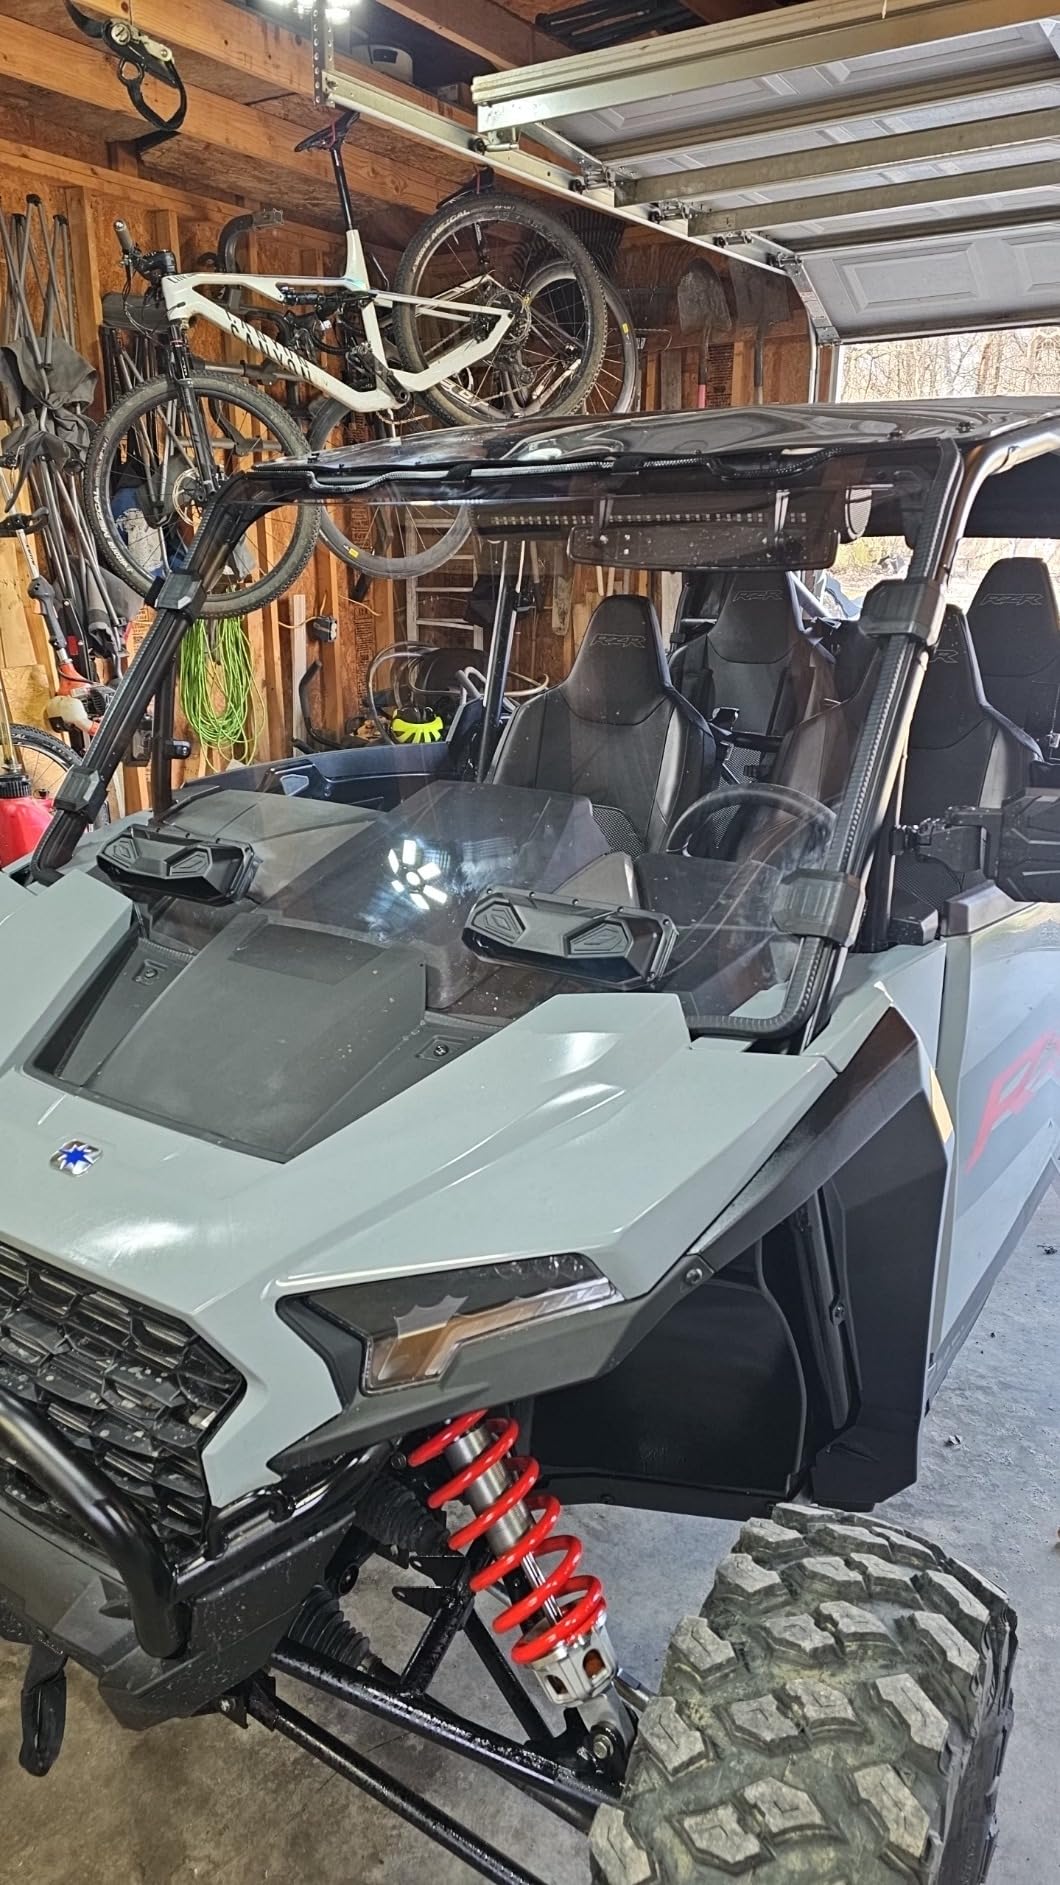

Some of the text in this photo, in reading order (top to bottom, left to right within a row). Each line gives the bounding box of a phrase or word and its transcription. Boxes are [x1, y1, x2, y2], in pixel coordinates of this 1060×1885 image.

[733, 590, 784, 602] RZR
[980, 593, 1044, 605] RZR
[589, 634, 646, 648] RZR
